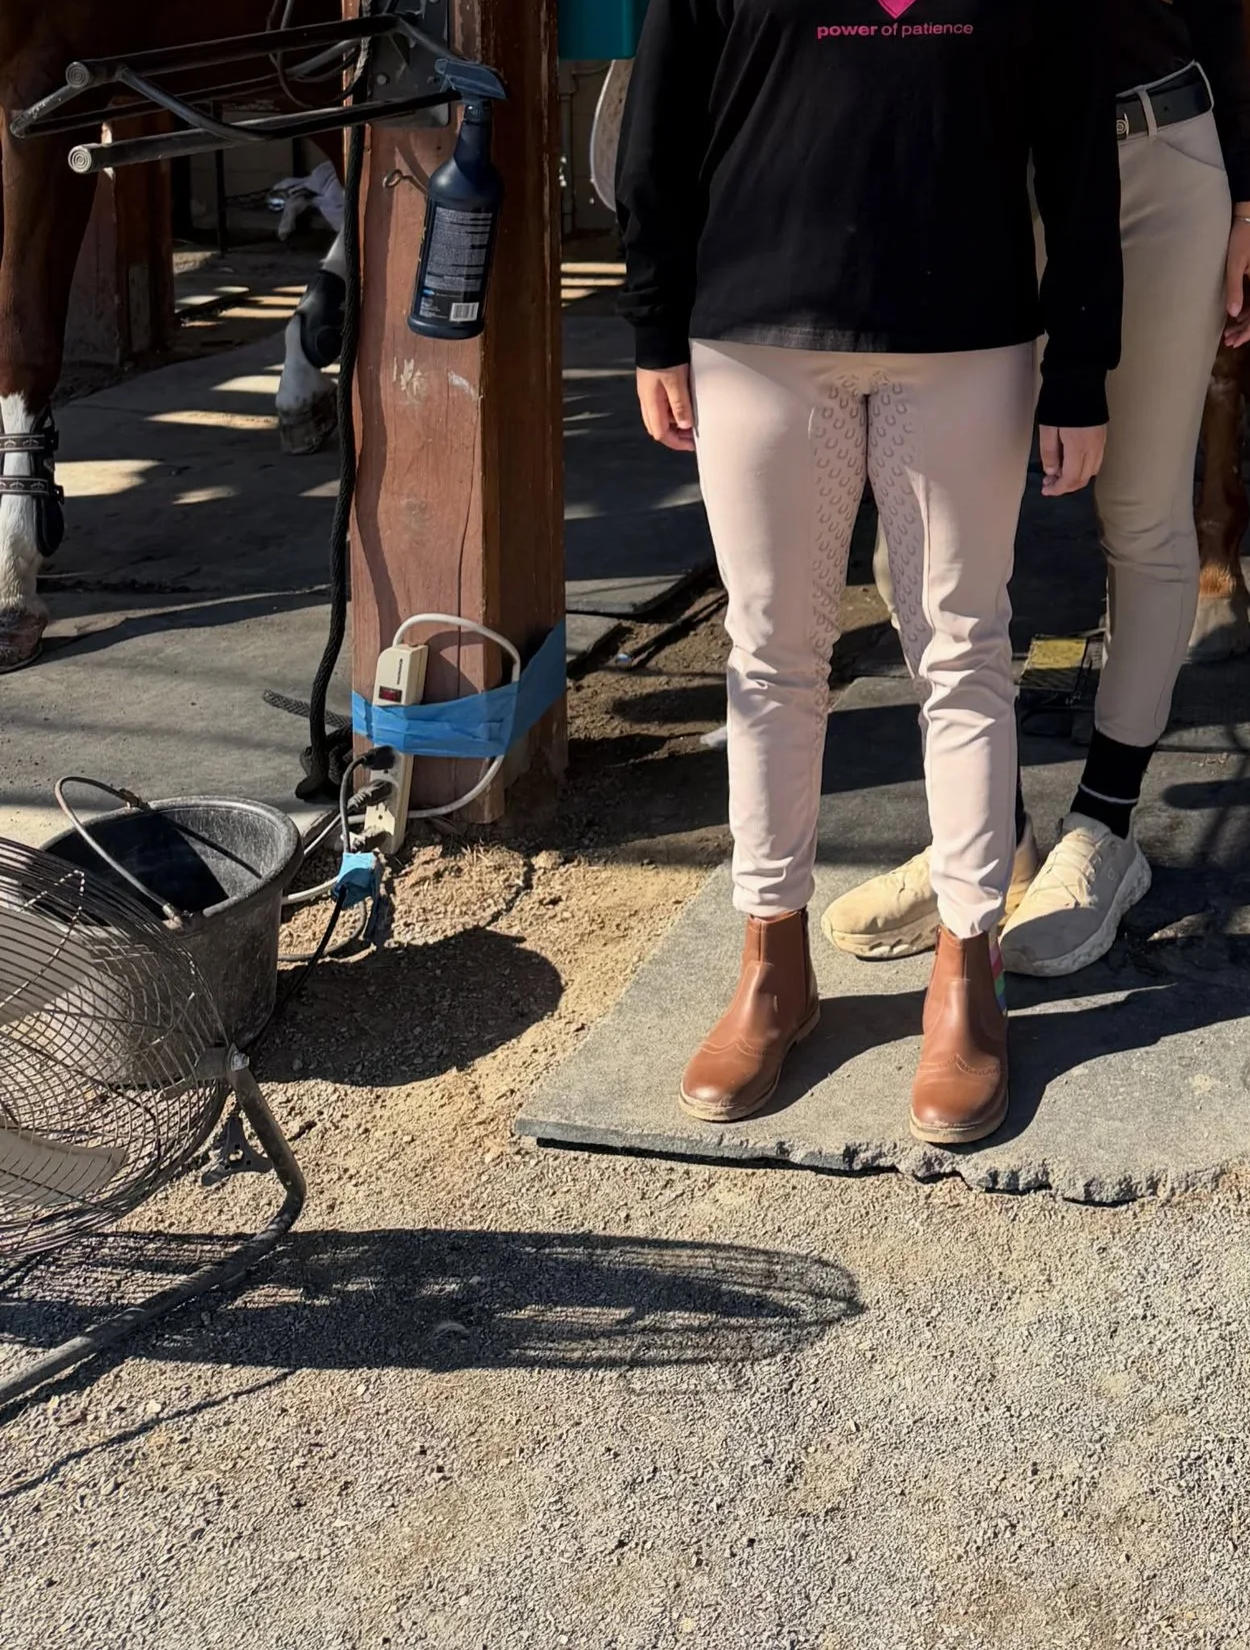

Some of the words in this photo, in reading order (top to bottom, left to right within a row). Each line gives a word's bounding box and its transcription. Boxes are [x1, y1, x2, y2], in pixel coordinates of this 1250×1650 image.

[817, 23, 878, 40] power
[881, 22, 899, 36] of
[902, 22, 974, 38] patience
